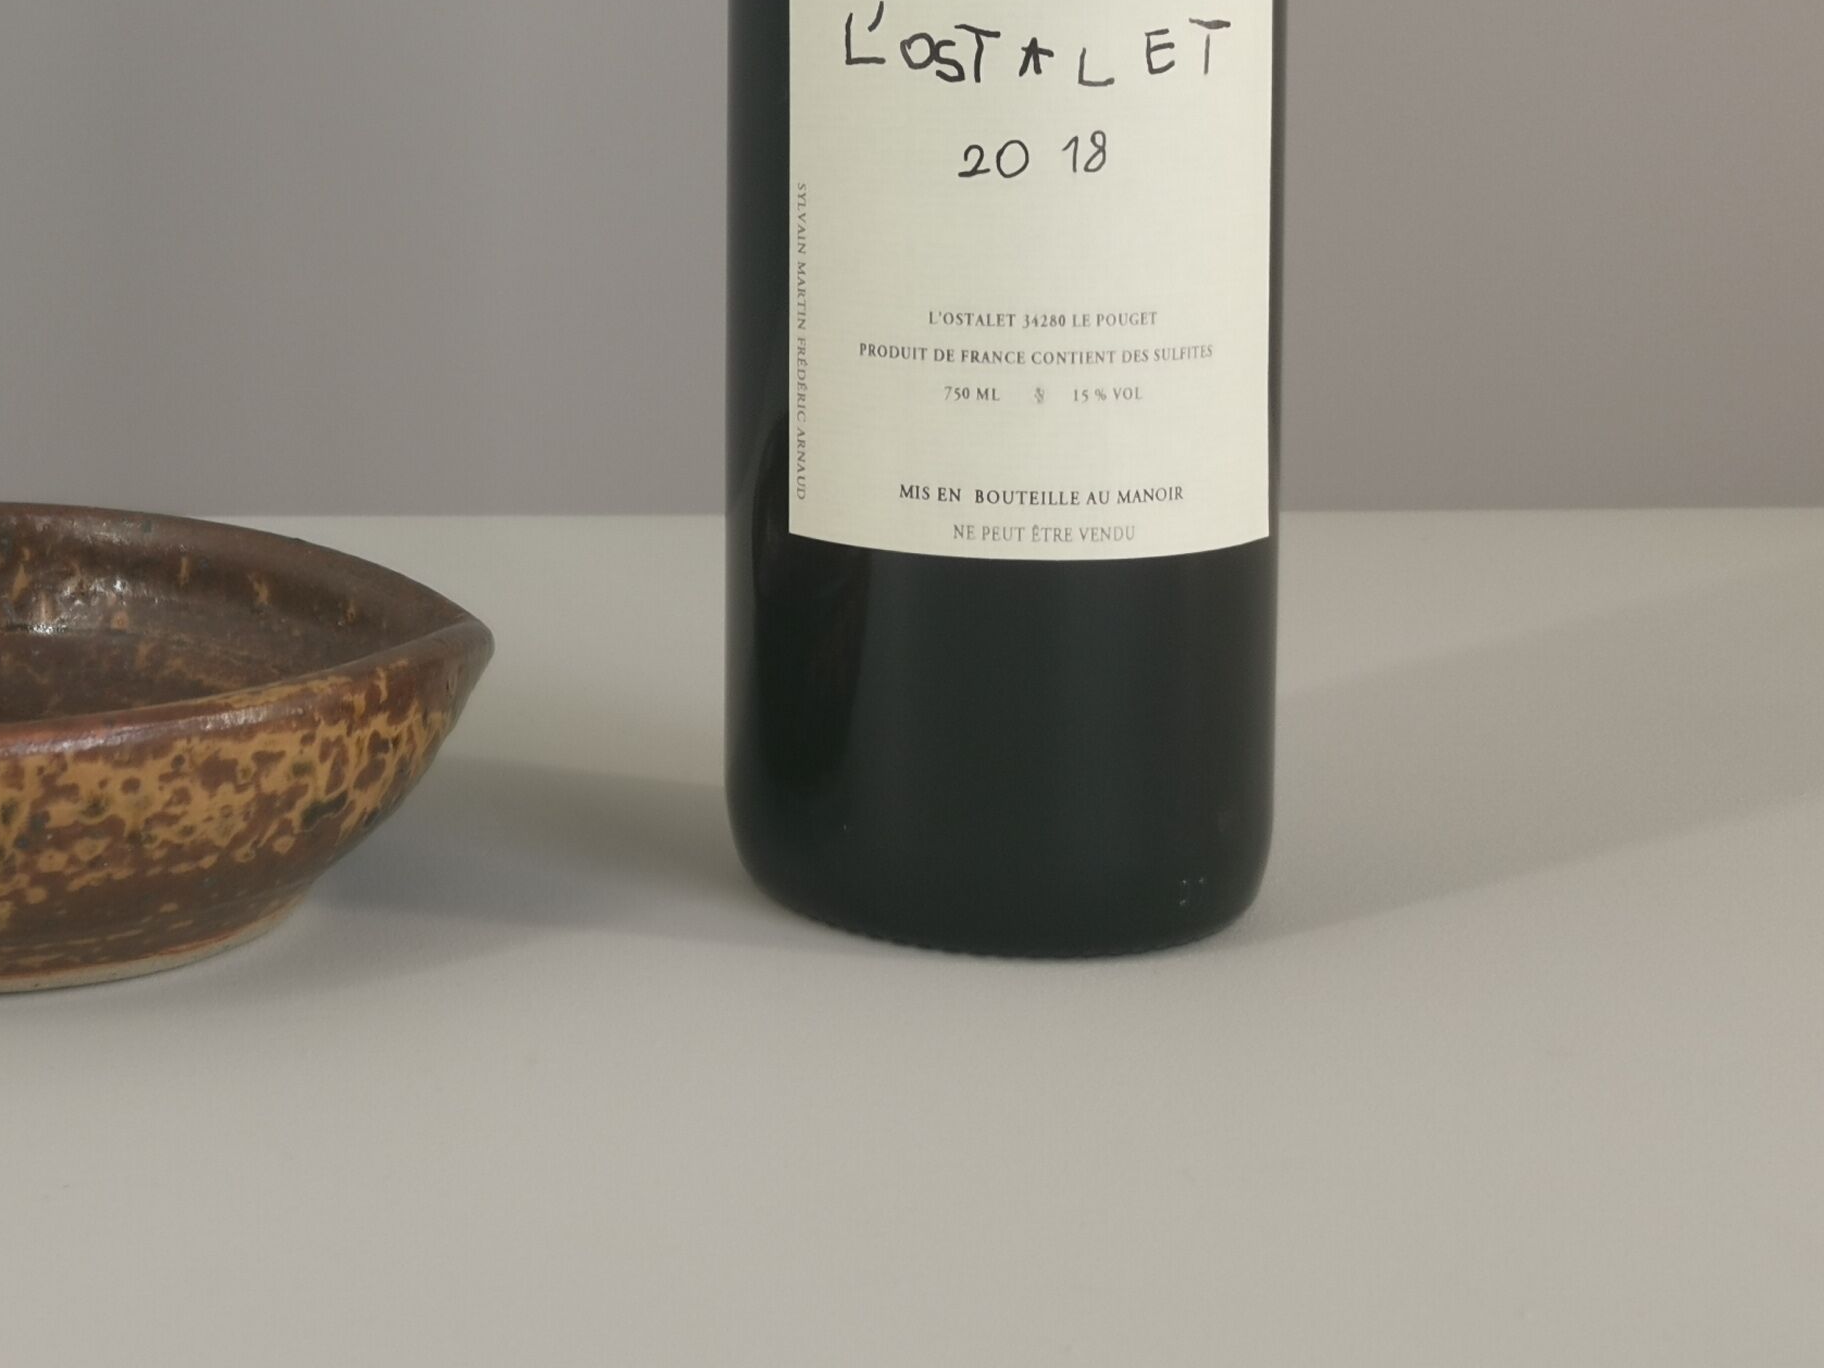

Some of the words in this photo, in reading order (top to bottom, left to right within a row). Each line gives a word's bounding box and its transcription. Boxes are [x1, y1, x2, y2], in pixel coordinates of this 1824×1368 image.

[844, 0, 1232, 88] L'OSTALET
[796, 182, 807, 255] SYLVAIN
[796, 261, 807, 330] MARTIN
[928, 309, 1017, 329] L'OSTALET
[1021, 313, 1067, 331] 34280
[1071, 313, 1092, 329] LE
[1095, 310, 1158, 328] POUGET
[859, 341, 929, 362] PRODUIT
[933, 347, 956, 364] DE
[960, 348, 1027, 366] FRANCE
[1030, 349, 1117, 366] CONTIENT
[1121, 348, 1150, 364] DES
[1153, 343, 1214, 363] SULFITES
[796, 337, 809, 423] FRÉDÉRIC
[943, 385, 971, 402] 750
[975, 386, 1001, 402] ML
[1073, 388, 1090, 404] 15
[1093, 387, 1108, 402] %
[1112, 386, 1143, 401] VOL
[796, 427, 807, 501] ARNAUD
[898, 483, 931, 501] MIS
[936, 486, 963, 503] EN
[974, 488, 1081, 507] BOUTEILLE
[1085, 489, 1111, 507] AU
[1116, 485, 1184, 505] MANOIR
[952, 523, 977, 541] NE
[981, 524, 1026, 543] PEUT
[1031, 523, 1073, 544] ÊTRE
[1078, 525, 1136, 543] VENDU
